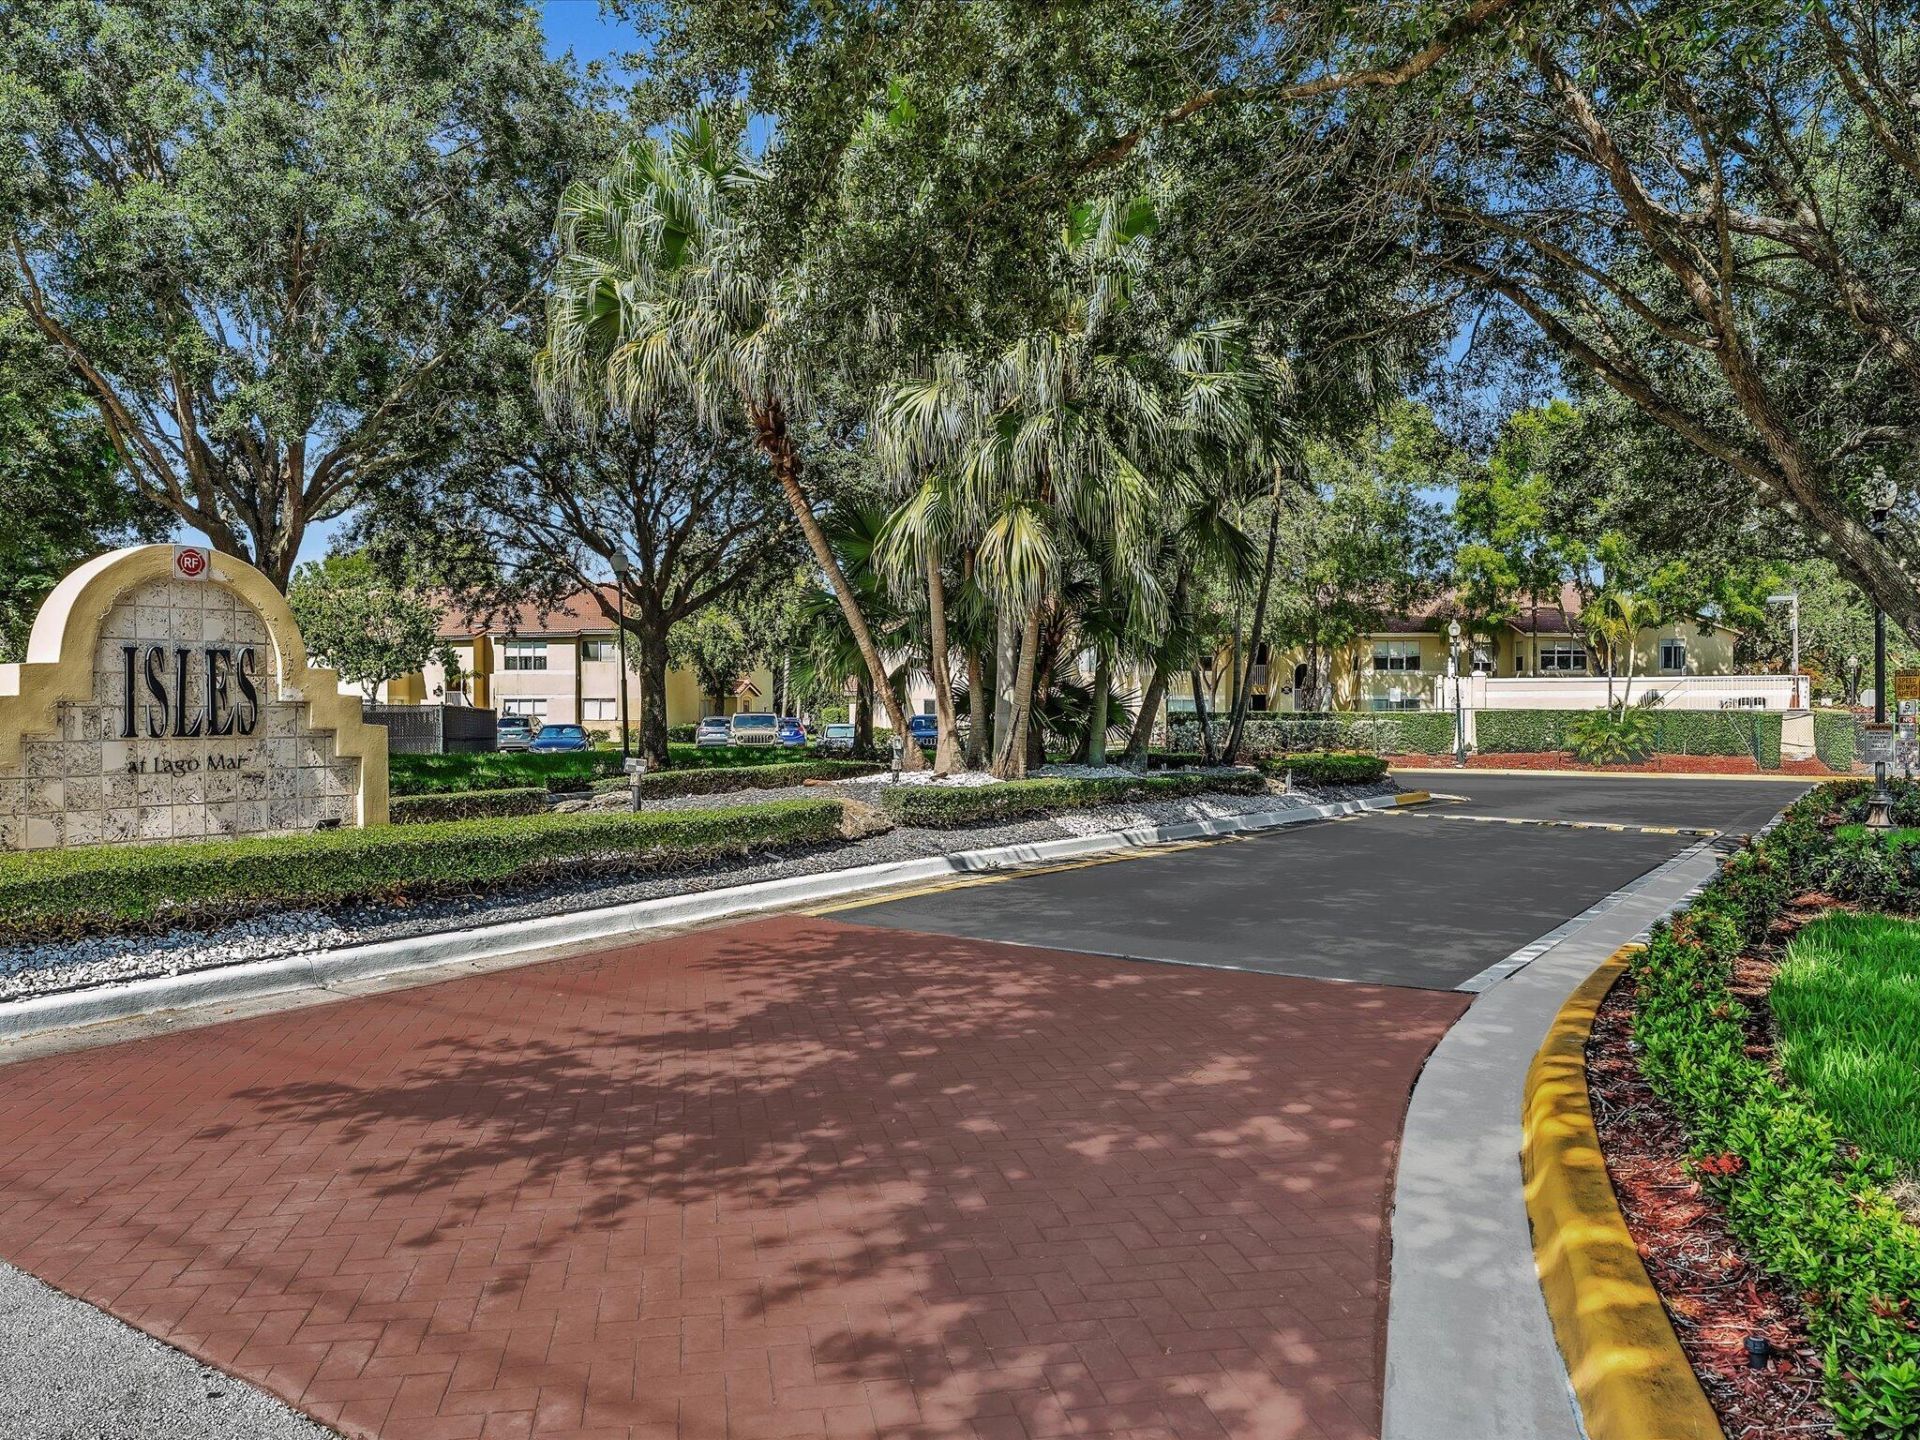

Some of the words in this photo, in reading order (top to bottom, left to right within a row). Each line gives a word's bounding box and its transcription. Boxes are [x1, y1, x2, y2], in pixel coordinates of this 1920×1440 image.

[184, 557, 199, 569] RF
[120, 646, 258, 738] ISLES
[1905, 702, 1911, 710] 5
[128, 757, 146, 774] at
[154, 757, 199, 778] Lago
[207, 754, 248, 771] Mar
